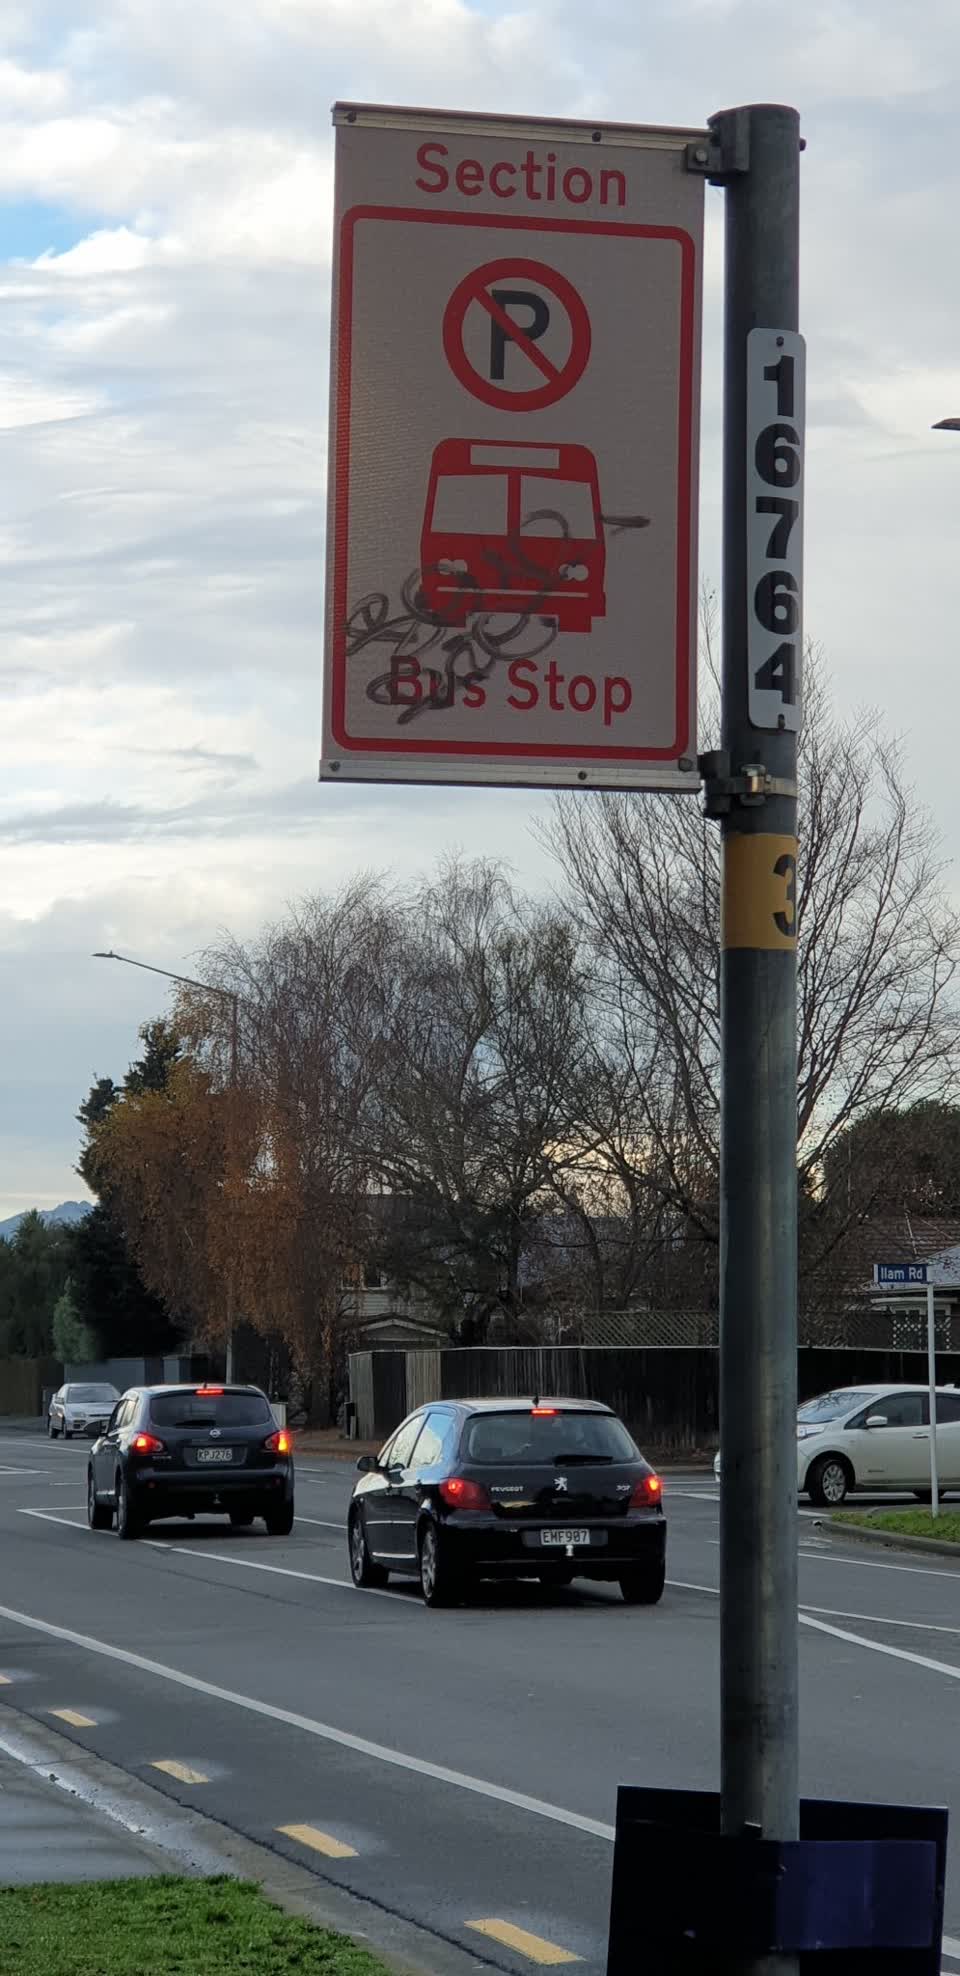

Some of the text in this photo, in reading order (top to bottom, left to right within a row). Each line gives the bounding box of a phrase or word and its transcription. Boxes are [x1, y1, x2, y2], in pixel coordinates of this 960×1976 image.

[415, 142, 626, 206] Section
[490, 289, 550, 380] P
[754, 354, 801, 706] 16764
[390, 655, 632, 726] Bus Stop
[773, 854, 797, 937] 3
[881, 1266, 923, 1280] Ilam Rd
[542, 1530, 588, 1543] EMF907
